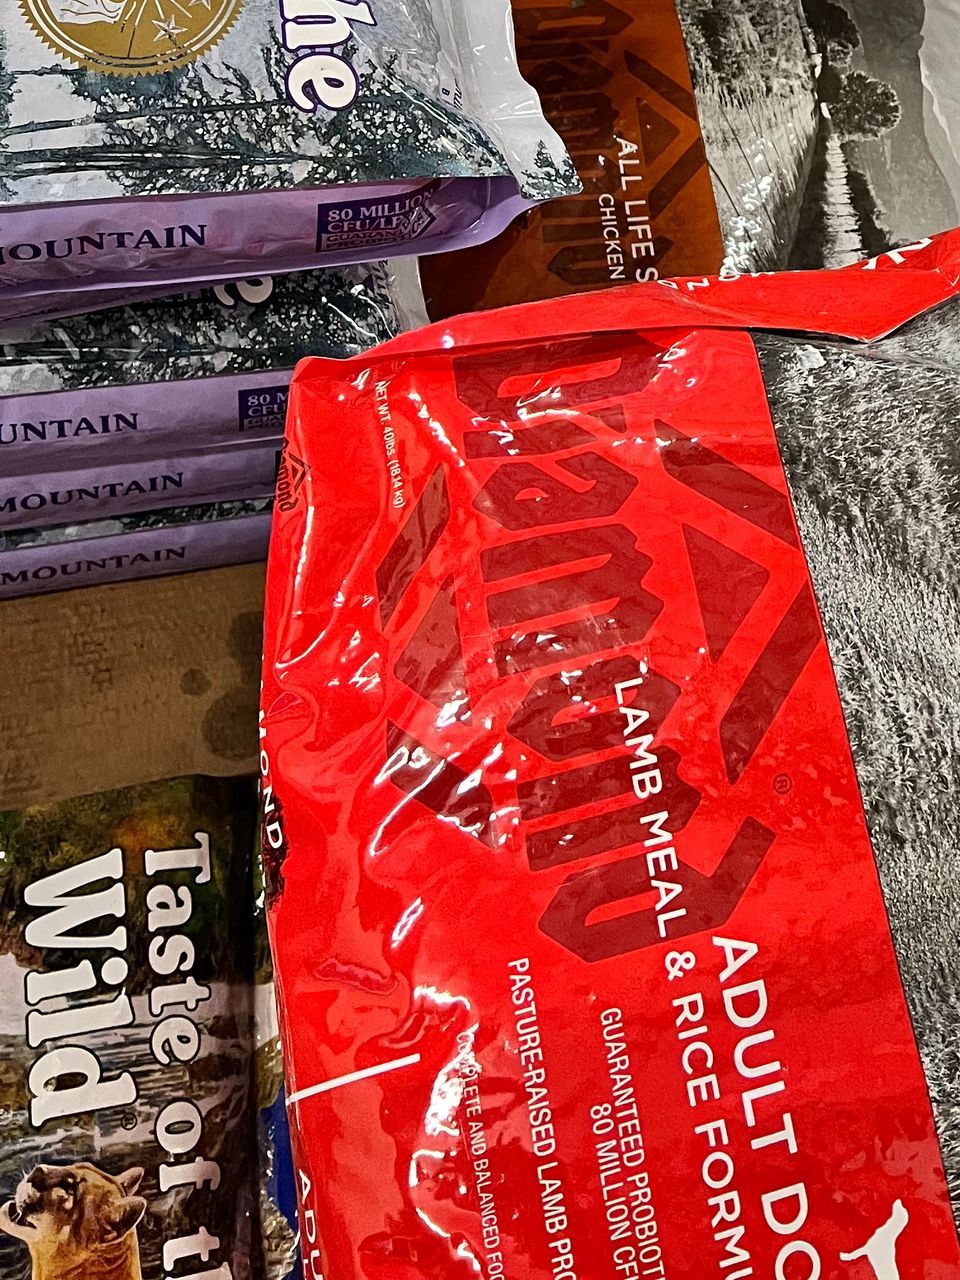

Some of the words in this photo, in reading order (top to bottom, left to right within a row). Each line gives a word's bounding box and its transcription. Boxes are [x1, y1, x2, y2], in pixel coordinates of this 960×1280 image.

[328, 209, 353, 222] 80
[360, 188, 433, 220] MILLION
[617, 137, 643, 191] ALL
[0, 224, 207, 263] OUNTAIN
[599, 194, 625, 279] CHICKEN
[625, 199, 655, 258] LIFE
[248, 394, 271, 407] 80
[375, 381, 387, 401] NET
[393, 491, 406, 509] kg)
[2, 545, 186, 584] MOUNTAIN
[615, 677, 664, 801] LAMB
[639, 810, 689, 939] MEAL
[22, 847, 138, 1130] Wild
[144, 831, 212, 1067] Taste
[665, 949, 696, 981] &
[600, 1007, 645, 1168] GUARANTEED
[673, 992, 722, 1108] RICE
[712, 935, 798, 1157] ADULT
[467, 1121, 487, 1156] AND
[507, 957, 557, 1157] PASTURE-RAISED
[537, 1161, 568, 1234] LAMB
[590, 1105, 615, 1135] 80
[153, 1099, 221, 1192] of
[595, 1141, 632, 1241] MILLION
[474, 1159, 500, 1250] BALANCED
